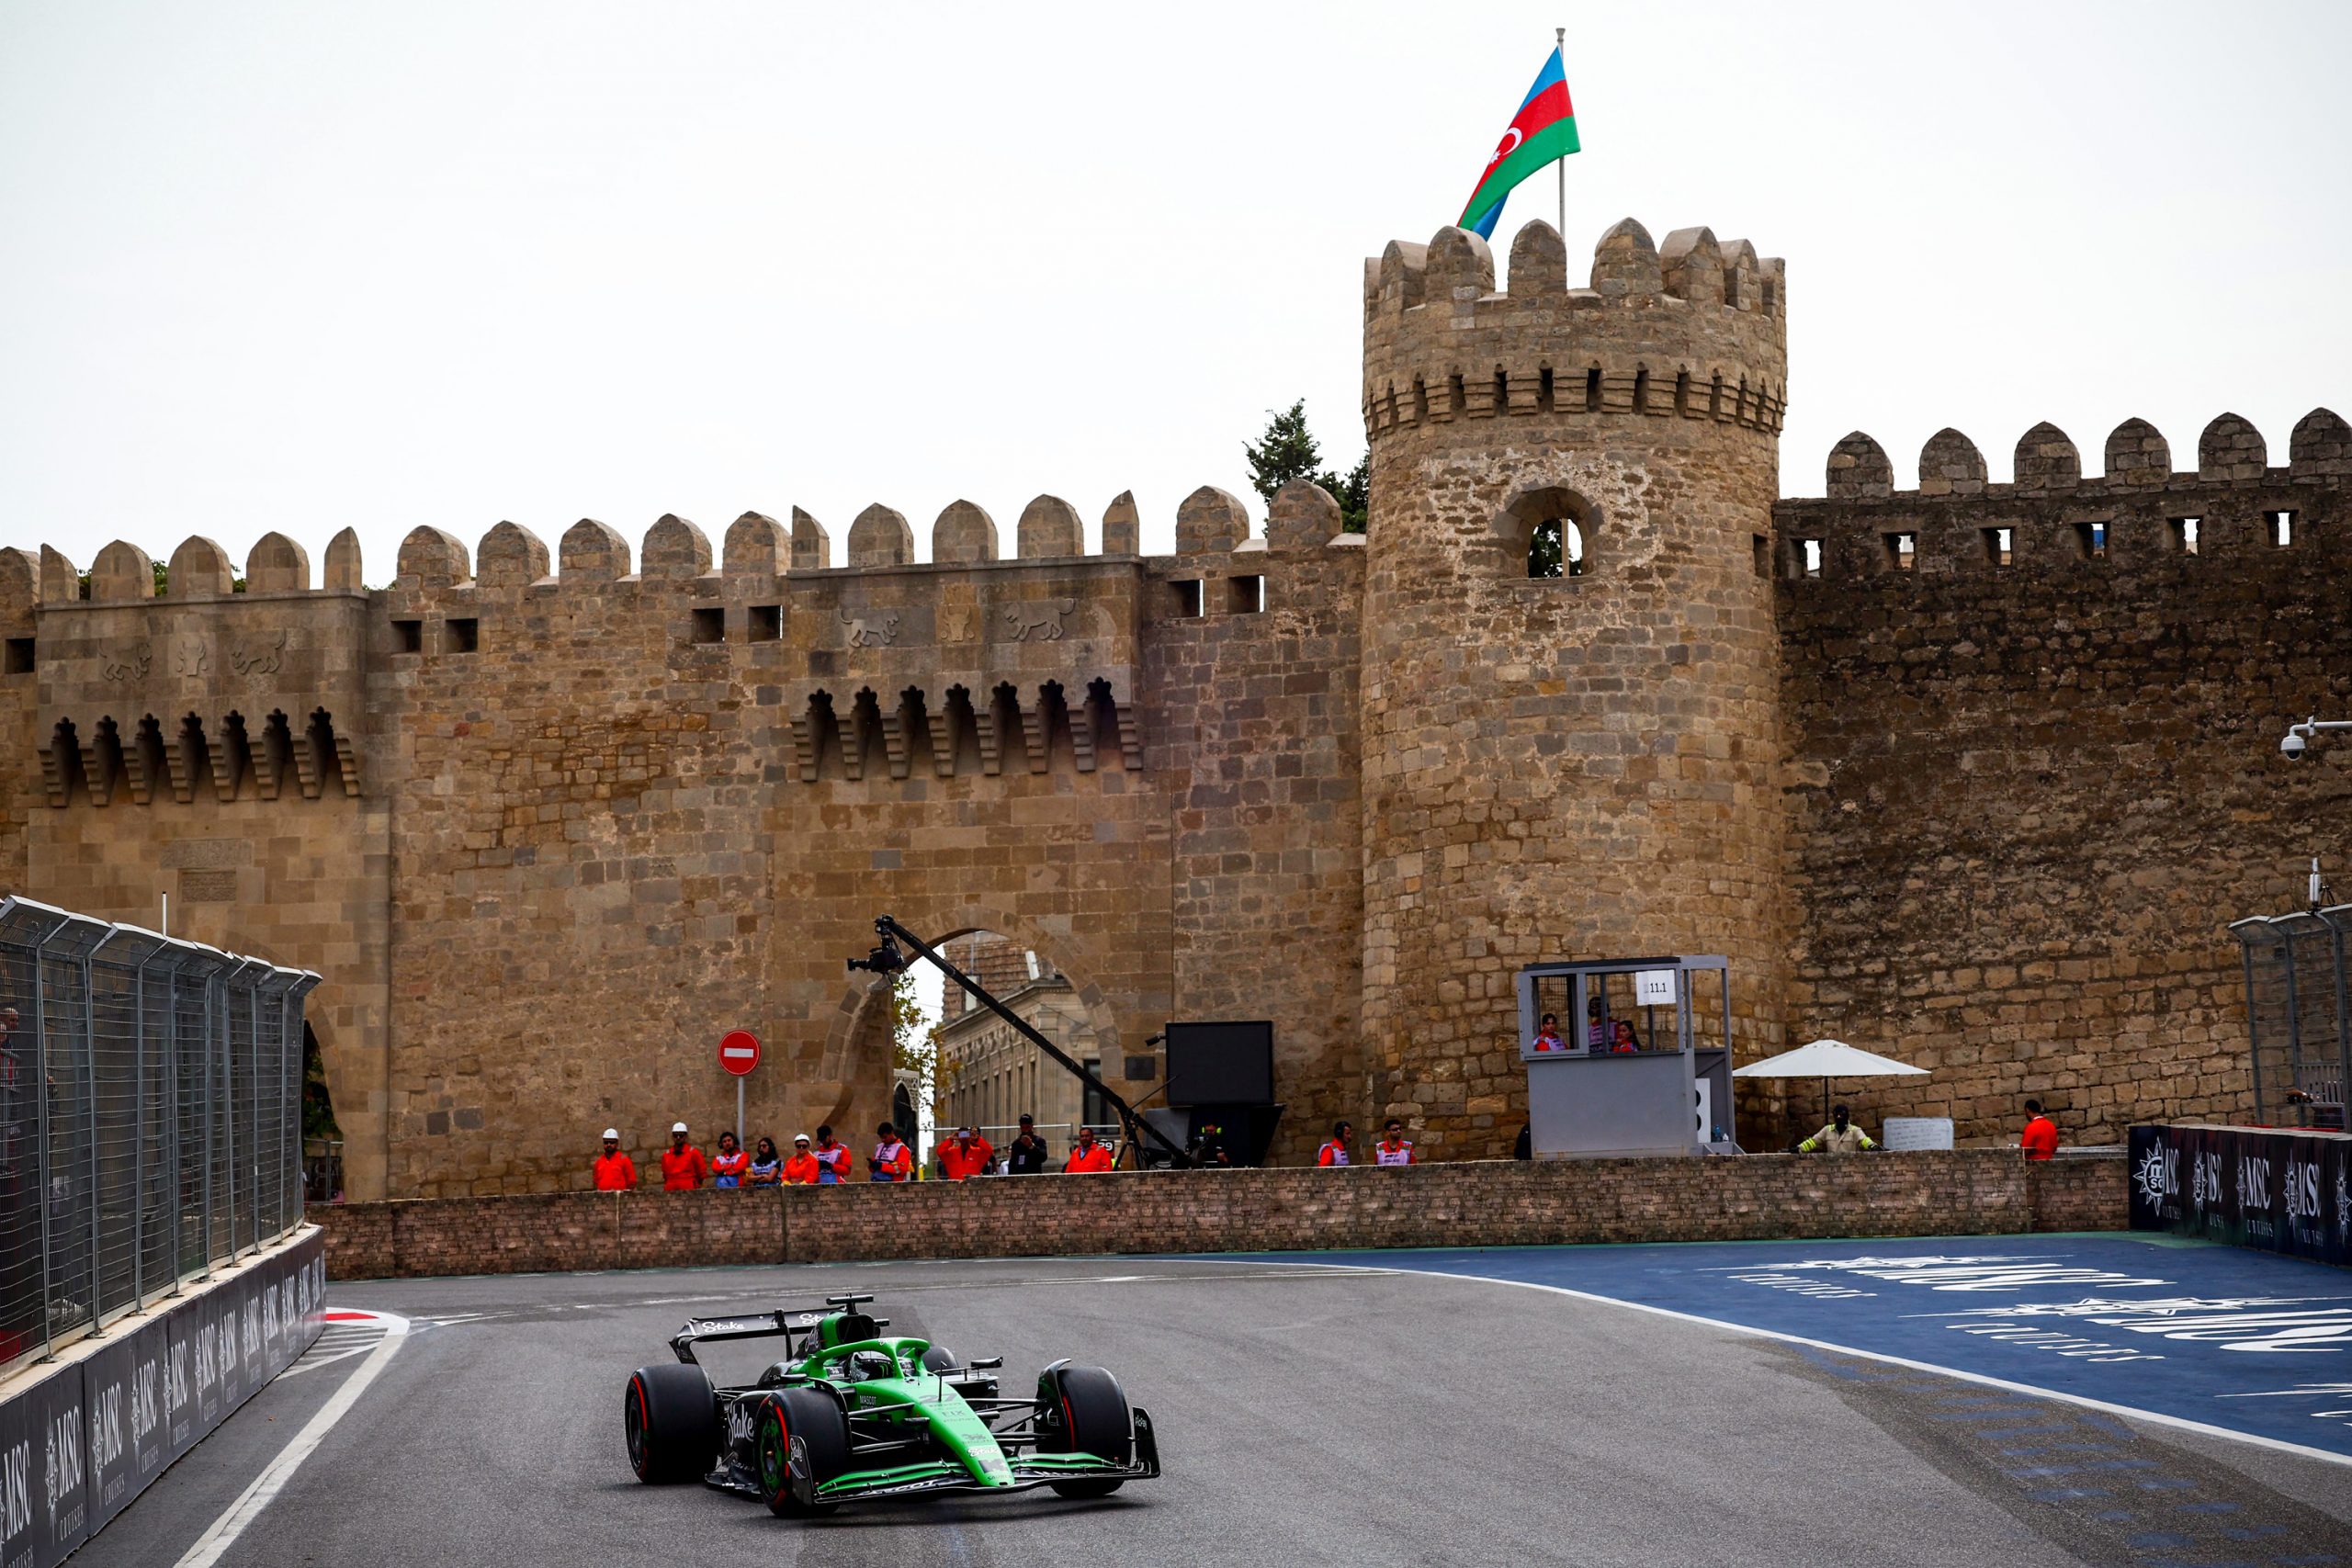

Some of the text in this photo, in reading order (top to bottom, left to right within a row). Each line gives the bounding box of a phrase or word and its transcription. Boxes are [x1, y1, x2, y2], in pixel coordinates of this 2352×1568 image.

[1650, 982, 1667, 993] 11.1
[2246, 1156, 2271, 1210] MSC
[2298, 1162, 2321, 1218] MSC
[702, 1321, 745, 1333] Stake
[140, 1359, 157, 1437] MSC
[171, 1339, 188, 1411] MSC
[919, 1393, 957, 1405] 27
[102, 1382, 122, 1466] MSC
[728, 1402, 754, 1448] Stake
[57, 1405, 82, 1499] MSC
[4, 1439, 31, 1541] MSC
[105, 1472, 125, 1506] CRUISES
[60, 1503, 84, 1541] CRUISES
